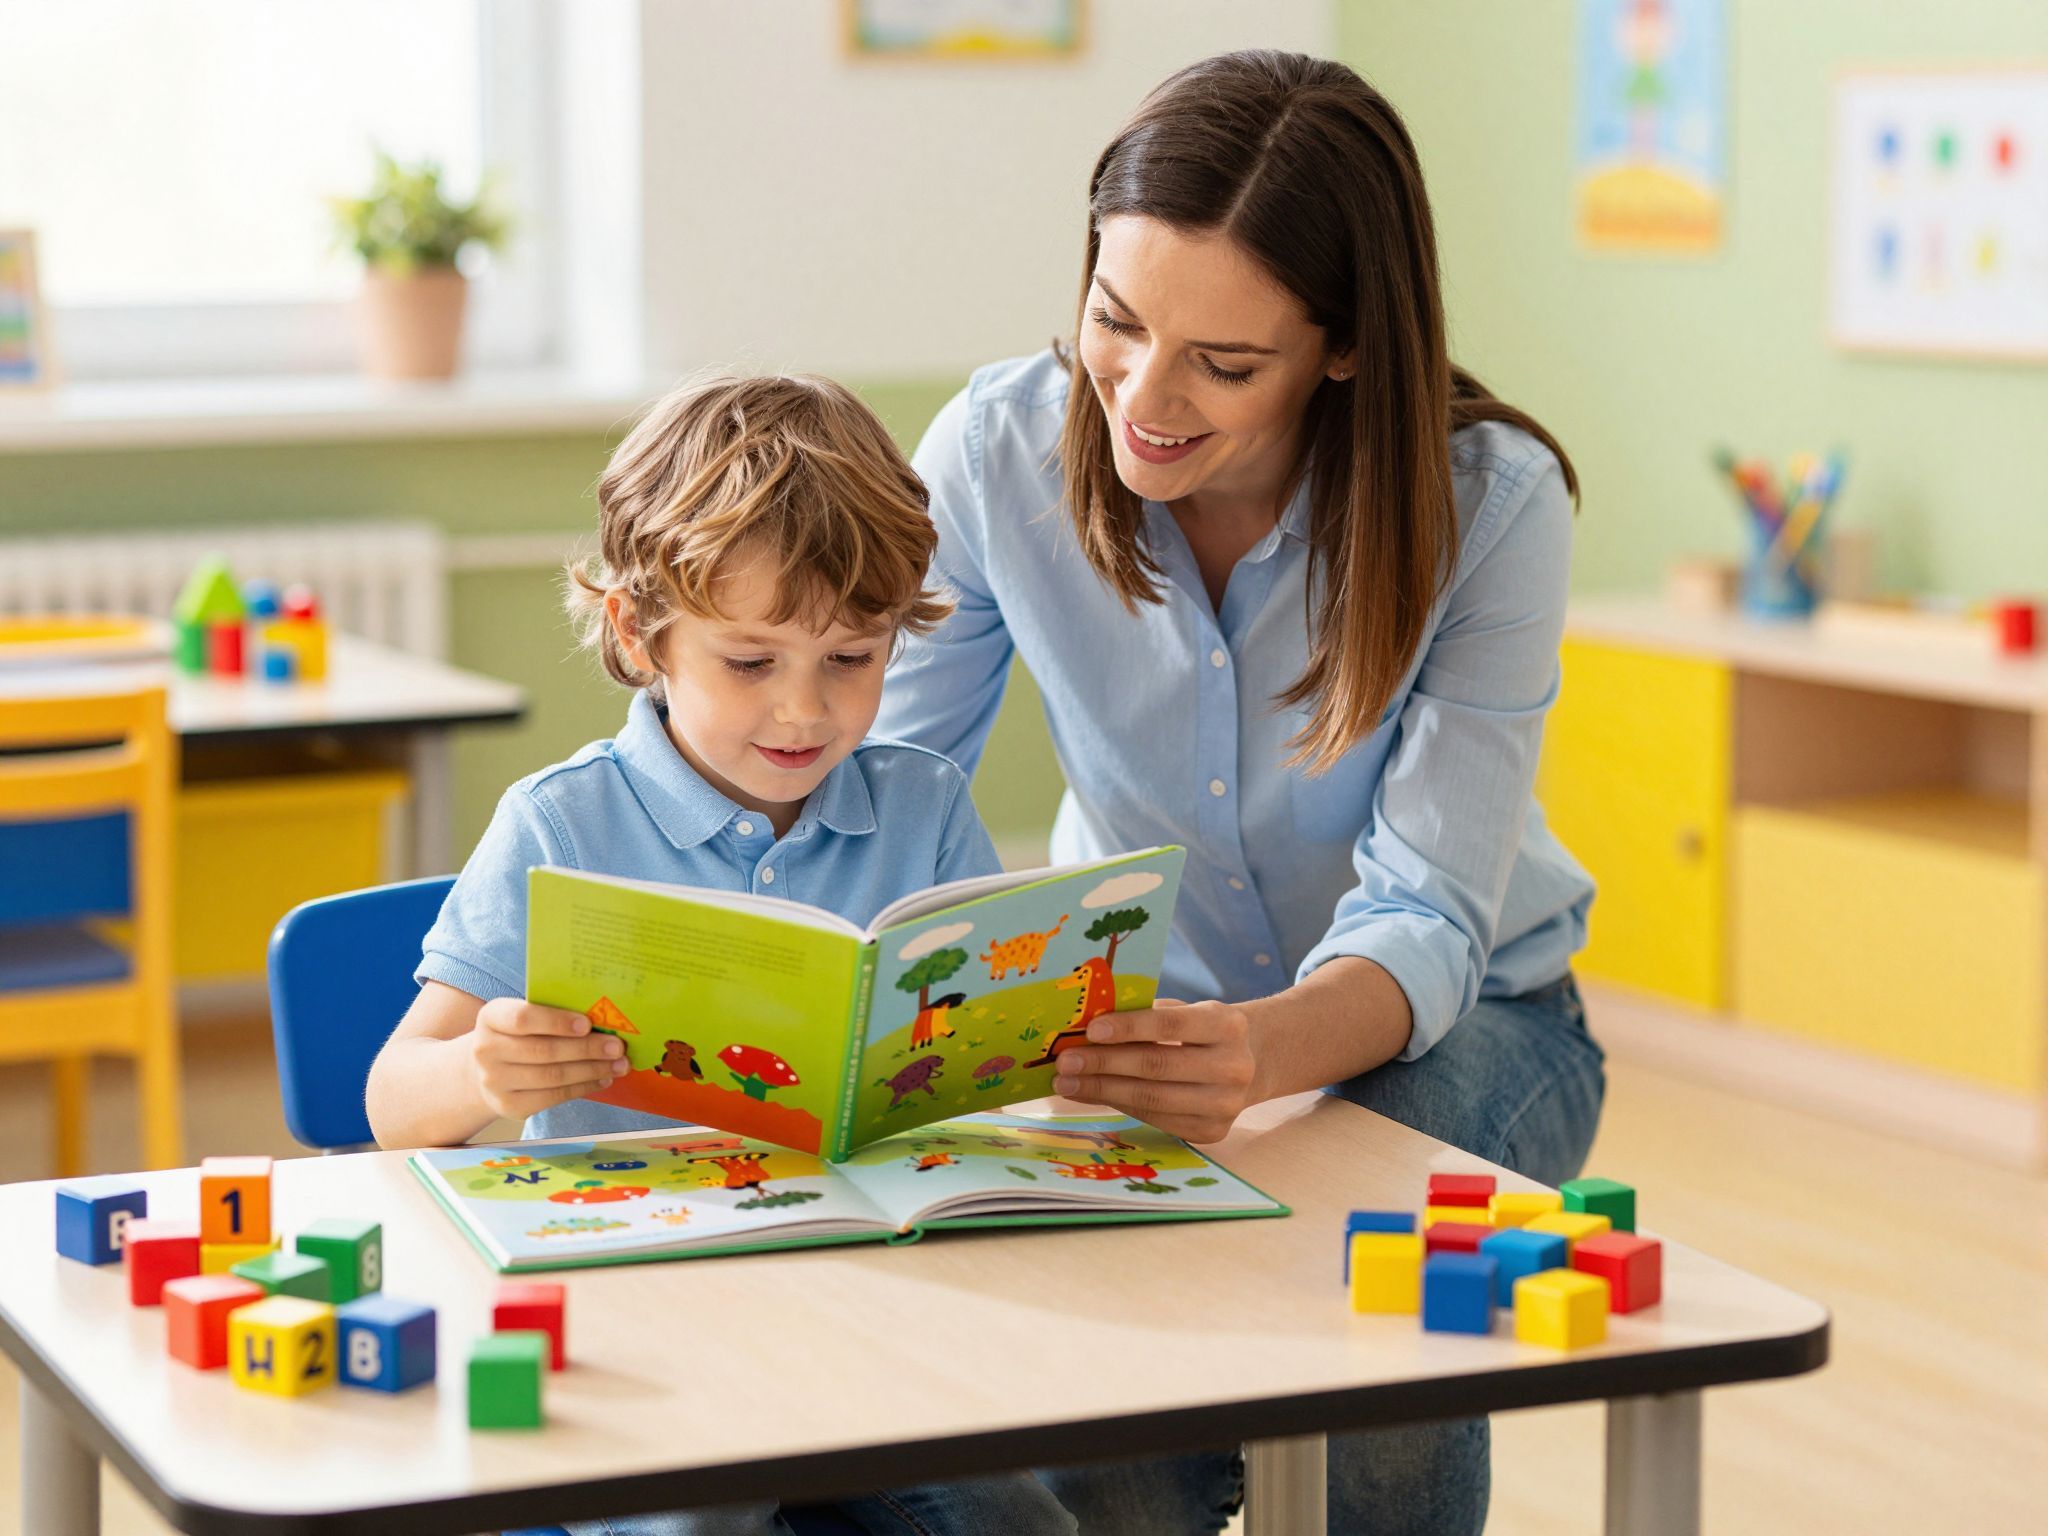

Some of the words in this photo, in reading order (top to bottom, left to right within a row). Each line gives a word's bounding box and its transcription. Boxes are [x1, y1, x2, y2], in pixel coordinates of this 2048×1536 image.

[221, 1187, 242, 1235] 1
[303, 1329, 326, 1379] 2
[347, 1327, 382, 1381] B
